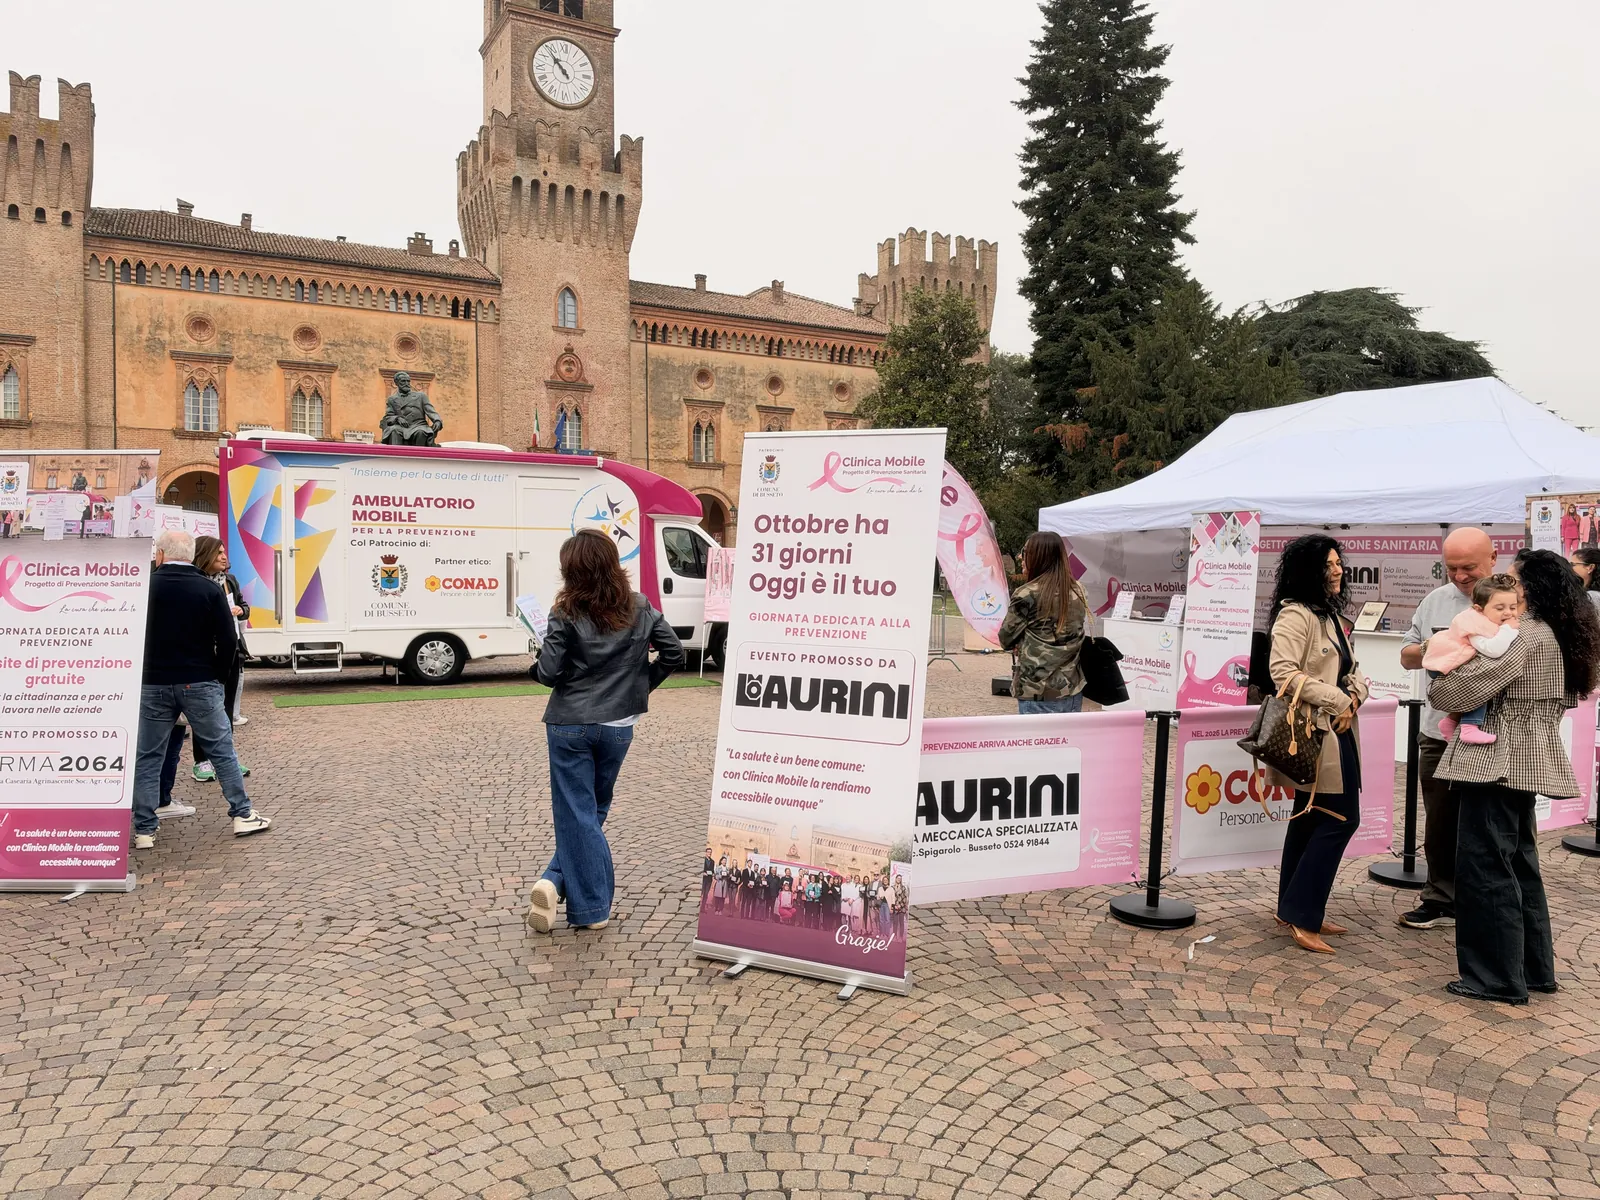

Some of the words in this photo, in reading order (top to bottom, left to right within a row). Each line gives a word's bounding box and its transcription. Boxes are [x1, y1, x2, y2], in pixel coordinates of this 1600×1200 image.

[842, 456, 881, 467] Clinica
[885, 456, 925, 467] Mobile
[400, 470, 419, 480] per
[422, 470, 432, 479] la
[434, 471, 468, 481] salute
[470, 472, 480, 481] di
[352, 495, 475, 510] AMBULATORIO
[352, 510, 417, 522] MOBILE
[754, 514, 849, 535] Ottobre
[855, 514, 889, 535] ha
[398, 528, 476, 536] PREVENZIONE
[350, 539, 366, 547] Col
[369, 539, 416, 548] Patrocinio
[419, 539, 431, 548] di:
[1373, 540, 1438, 550] SANITARIA
[752, 542, 774, 563] 31
[779, 542, 852, 570] giorni
[24, 562, 80, 577] Clinica
[85, 562, 140, 577] Mobile
[1204, 562, 1226, 570] Clinica
[1228, 562, 1252, 570] Mobile
[24, 580, 55, 590] Progetto
[65, 580, 108, 588] Prevenzione
[110, 580, 141, 588] Sanitaria
[442, 578, 499, 590] CONAD
[749, 572, 805, 600] Oggi
[812, 572, 827, 594] è
[833, 573, 846, 595] il
[852, 574, 897, 597] tuo
[1121, 582, 1152, 592] Clinica
[1154, 582, 1186, 592] Mobile
[749, 612, 809, 624] GIORNATA
[813, 614, 875, 627] DEDICATA
[880, 616, 911, 629] ALLA
[45, 627, 100, 635] DEDICATA
[103, 627, 129, 635] ALLA
[785, 627, 867, 640] PREVENZIONE
[25, 656, 39, 668] di
[42, 656, 132, 672] prevenzione
[750, 651, 796, 662] EVENTO
[800, 653, 874, 667] PROMOSSO
[878, 657, 897, 669] DA
[1145, 657, 1170, 669] Mobile
[25, 672, 85, 689] gratuite
[1372, 680, 1389, 688] Clinica
[1391, 682, 1410, 690] Mobile
[1212, 682, 1246, 696] Grazie!
[14, 692, 78, 701] cittadinanza
[80, 693, 87, 701] e
[88, 693, 104, 703] per
[107, 692, 123, 701] chi
[2, 706, 34, 714] lavora
[36, 706, 61, 714] nelle
[63, 706, 102, 714] aziende
[32, 731, 98, 739] PROMOSSO
[102, 731, 118, 739] DA
[1192, 730, 1204, 738] NEL
[924, 740, 977, 751] PREVENZIONE
[978, 739, 1006, 749] ARRIVA
[1007, 739, 1033, 747] ANCHE
[1034, 738, 1060, 746] GRAZIE
[1061, 737, 1069, 745] A:
[742, 751, 772, 763] salute
[773, 753, 779, 763] è
[780, 756, 793, 765] un
[795, 755, 820, 767] bene
[821, 760, 865, 773] comune:
[723, 770, 740, 780] con
[742, 770, 774, 784] Clinica
[775, 774, 808, 788] Mobile
[810, 778, 820, 789] la
[821, 781, 871, 795] rendiamo
[720, 790, 772, 804] accessibile
[915, 772, 1080, 827] AURINI
[1220, 811, 1266, 826] Persone
[26, 829, 50, 837] salute
[51, 829, 56, 837] è
[68, 829, 87, 837] bene
[921, 827, 993, 843] MECCANICA
[996, 820, 1078, 836] SPECIALIZZATA
[21, 843, 47, 852] Clinica
[47, 843, 73, 852] Mobile
[74, 843, 81, 852] la
[82, 843, 119, 852] rendiamo
[968, 841, 1001, 852] Busseto
[1004, 840, 1024, 849] 0524
[1026, 838, 1050, 847] 91844
[39, 857, 82, 866] accessibile
[835, 924, 896, 954] Grazie!
